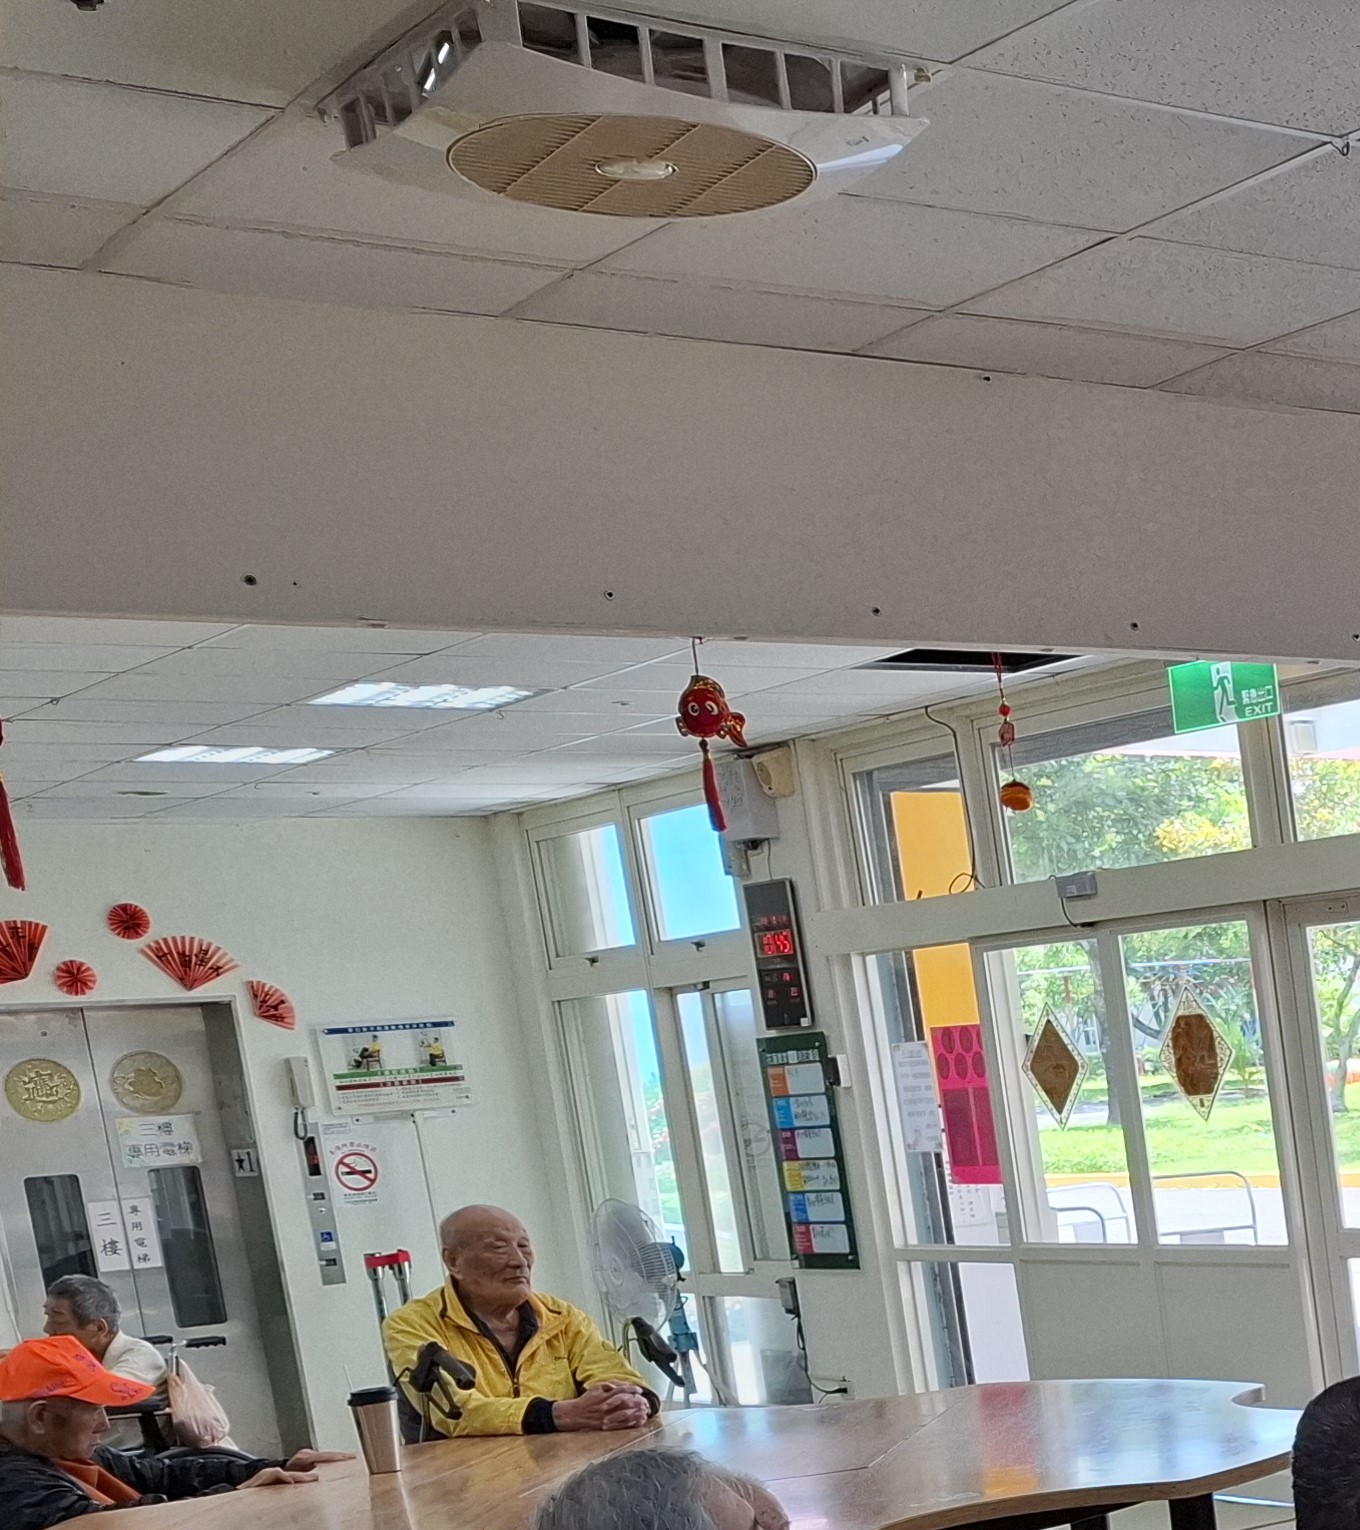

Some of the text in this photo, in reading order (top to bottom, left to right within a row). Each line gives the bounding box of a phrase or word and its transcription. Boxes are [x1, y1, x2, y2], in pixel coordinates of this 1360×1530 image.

[1245, 702, 1274, 717] EXIT
[127, 1204, 151, 1264] 專用電梯
